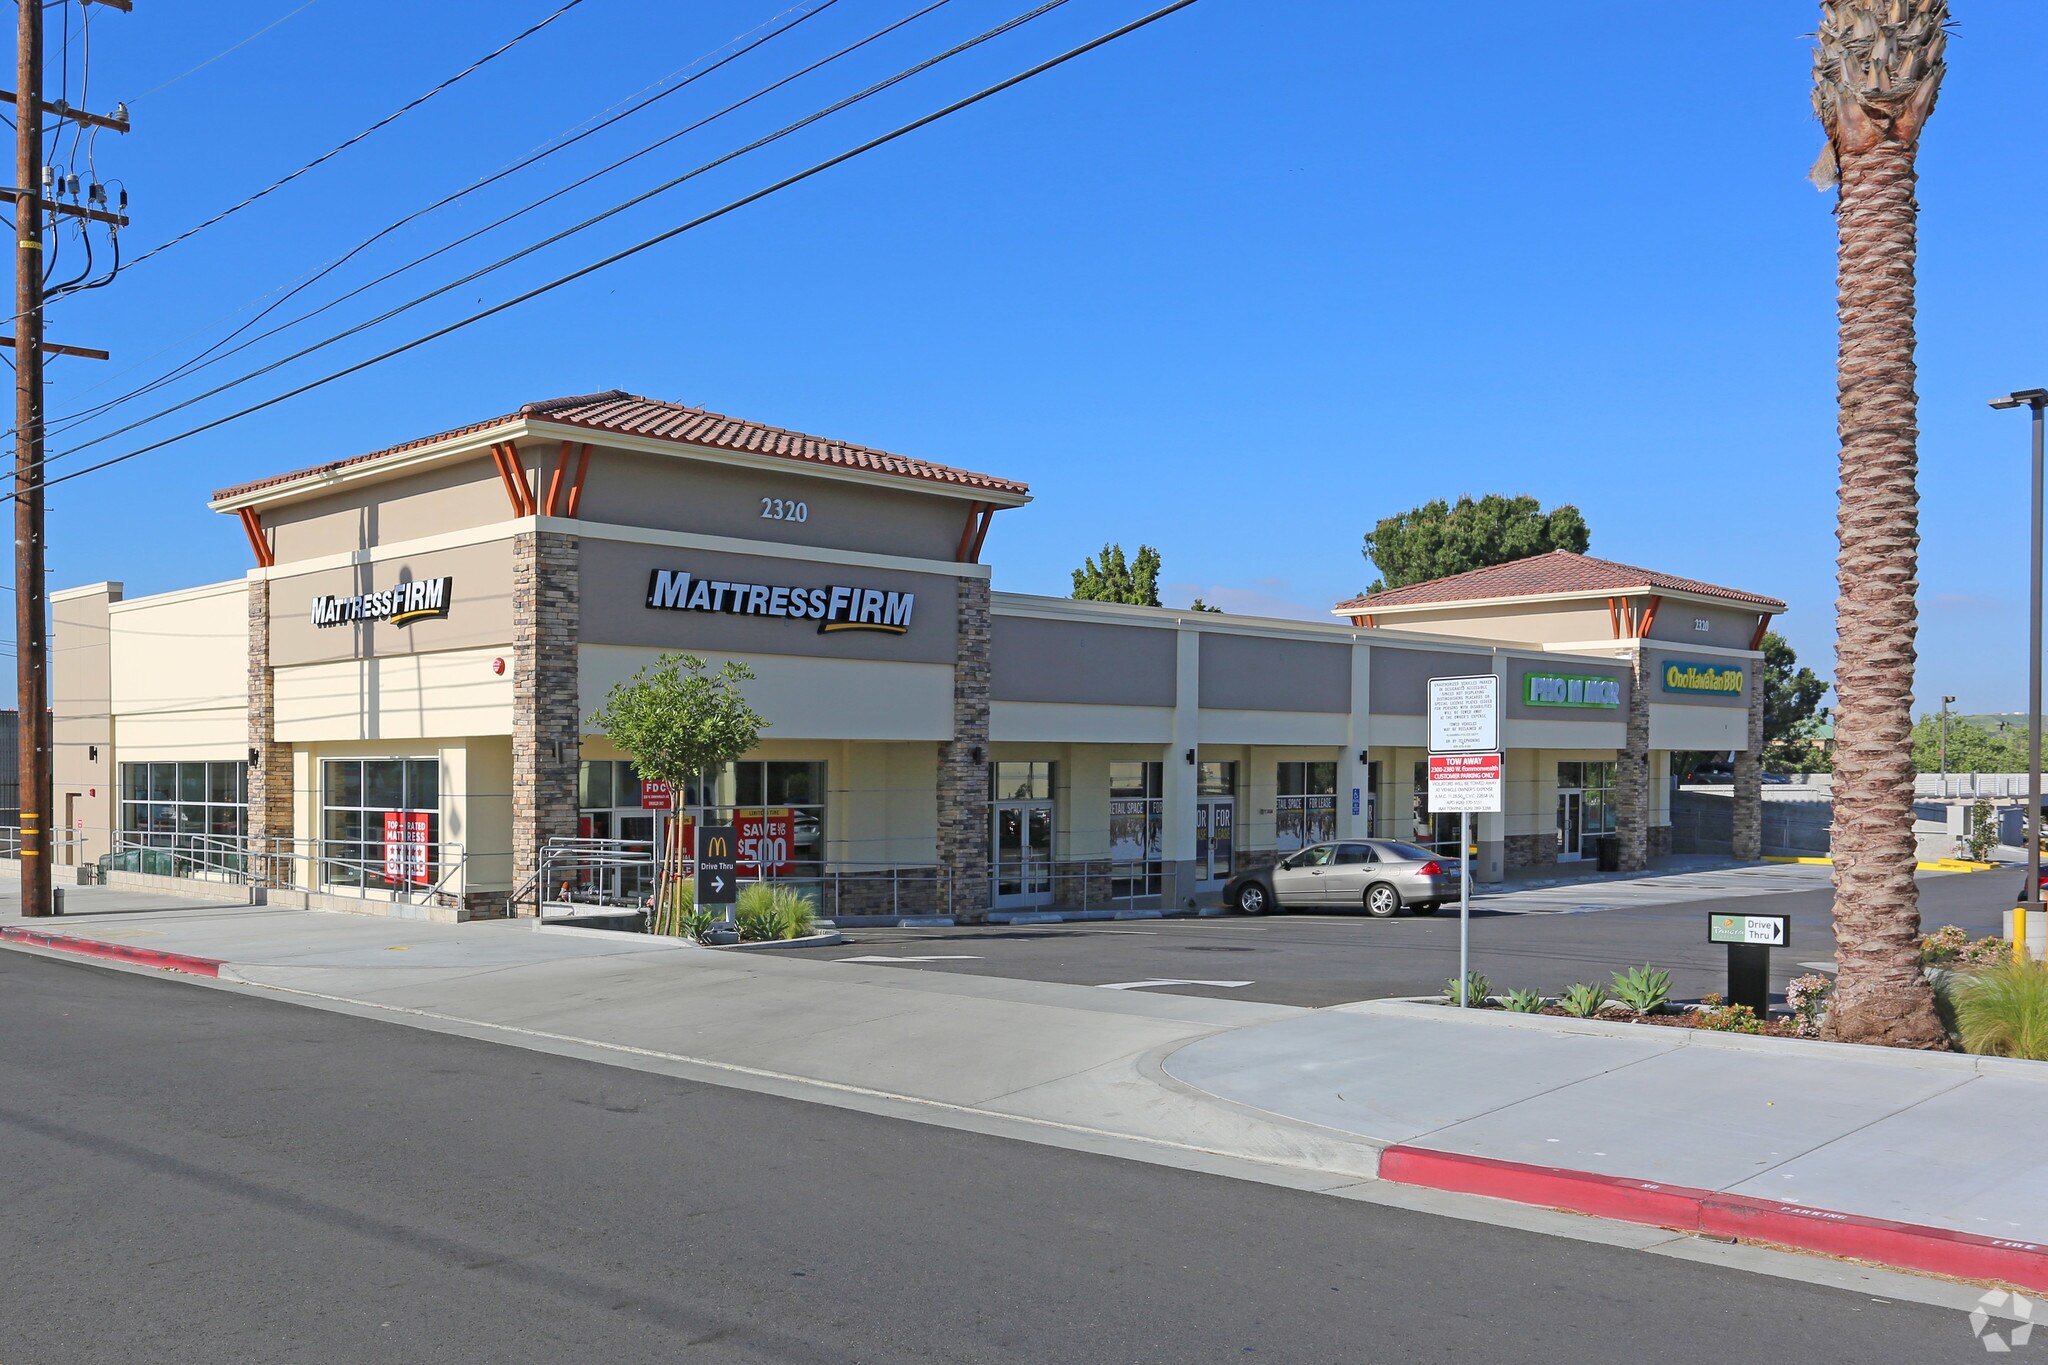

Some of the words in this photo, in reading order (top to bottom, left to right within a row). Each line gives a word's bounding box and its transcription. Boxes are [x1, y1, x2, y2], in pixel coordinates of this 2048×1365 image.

[760, 498, 808, 522] 2320
[1695, 618, 1710, 632] 2320
[1722, 671, 1744, 692] BBQ
[1127, 802, 1144, 814] SPACE
[1288, 798, 1302, 808] SPACE
[1309, 798, 1318, 808] FOR
[1318, 798, 1332, 808] LEASE
[1196, 810, 1207, 827] OR
[1216, 810, 1230, 827] FOR
[743, 824, 776, 836] SAVE
[1216, 828, 1230, 840] LEASE
[1748, 920, 1771, 929] Drive
[1749, 931, 1769, 939] Thru
[1780, 1206, 1848, 1220] PARKING
